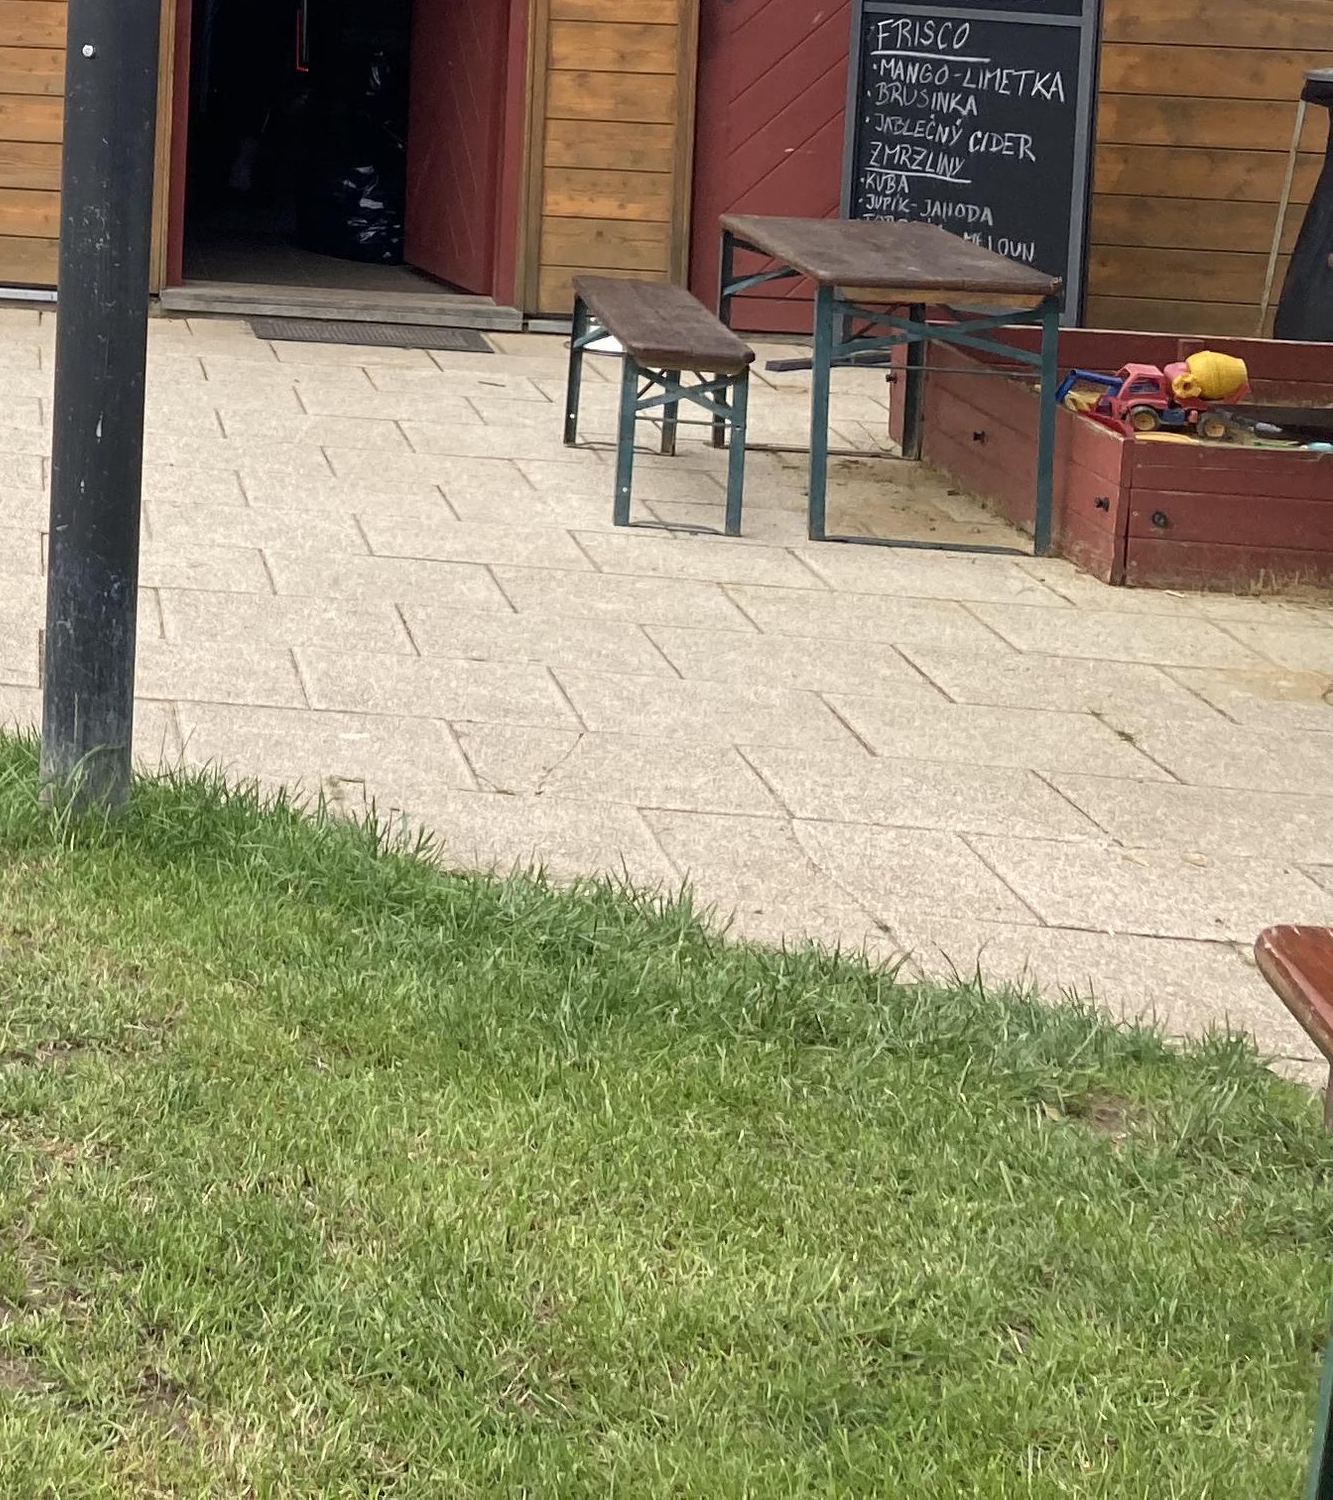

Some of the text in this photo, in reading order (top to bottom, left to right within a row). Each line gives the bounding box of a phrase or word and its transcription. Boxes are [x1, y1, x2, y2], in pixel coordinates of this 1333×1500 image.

[876, 18, 970, 50] FRISCO
[875, 82, 978, 116] BRUSINKA
[869, 141, 965, 177] ZMRZLINY
[968, 131, 1036, 162] CIDER
[865, 172, 909, 194] KUBA
